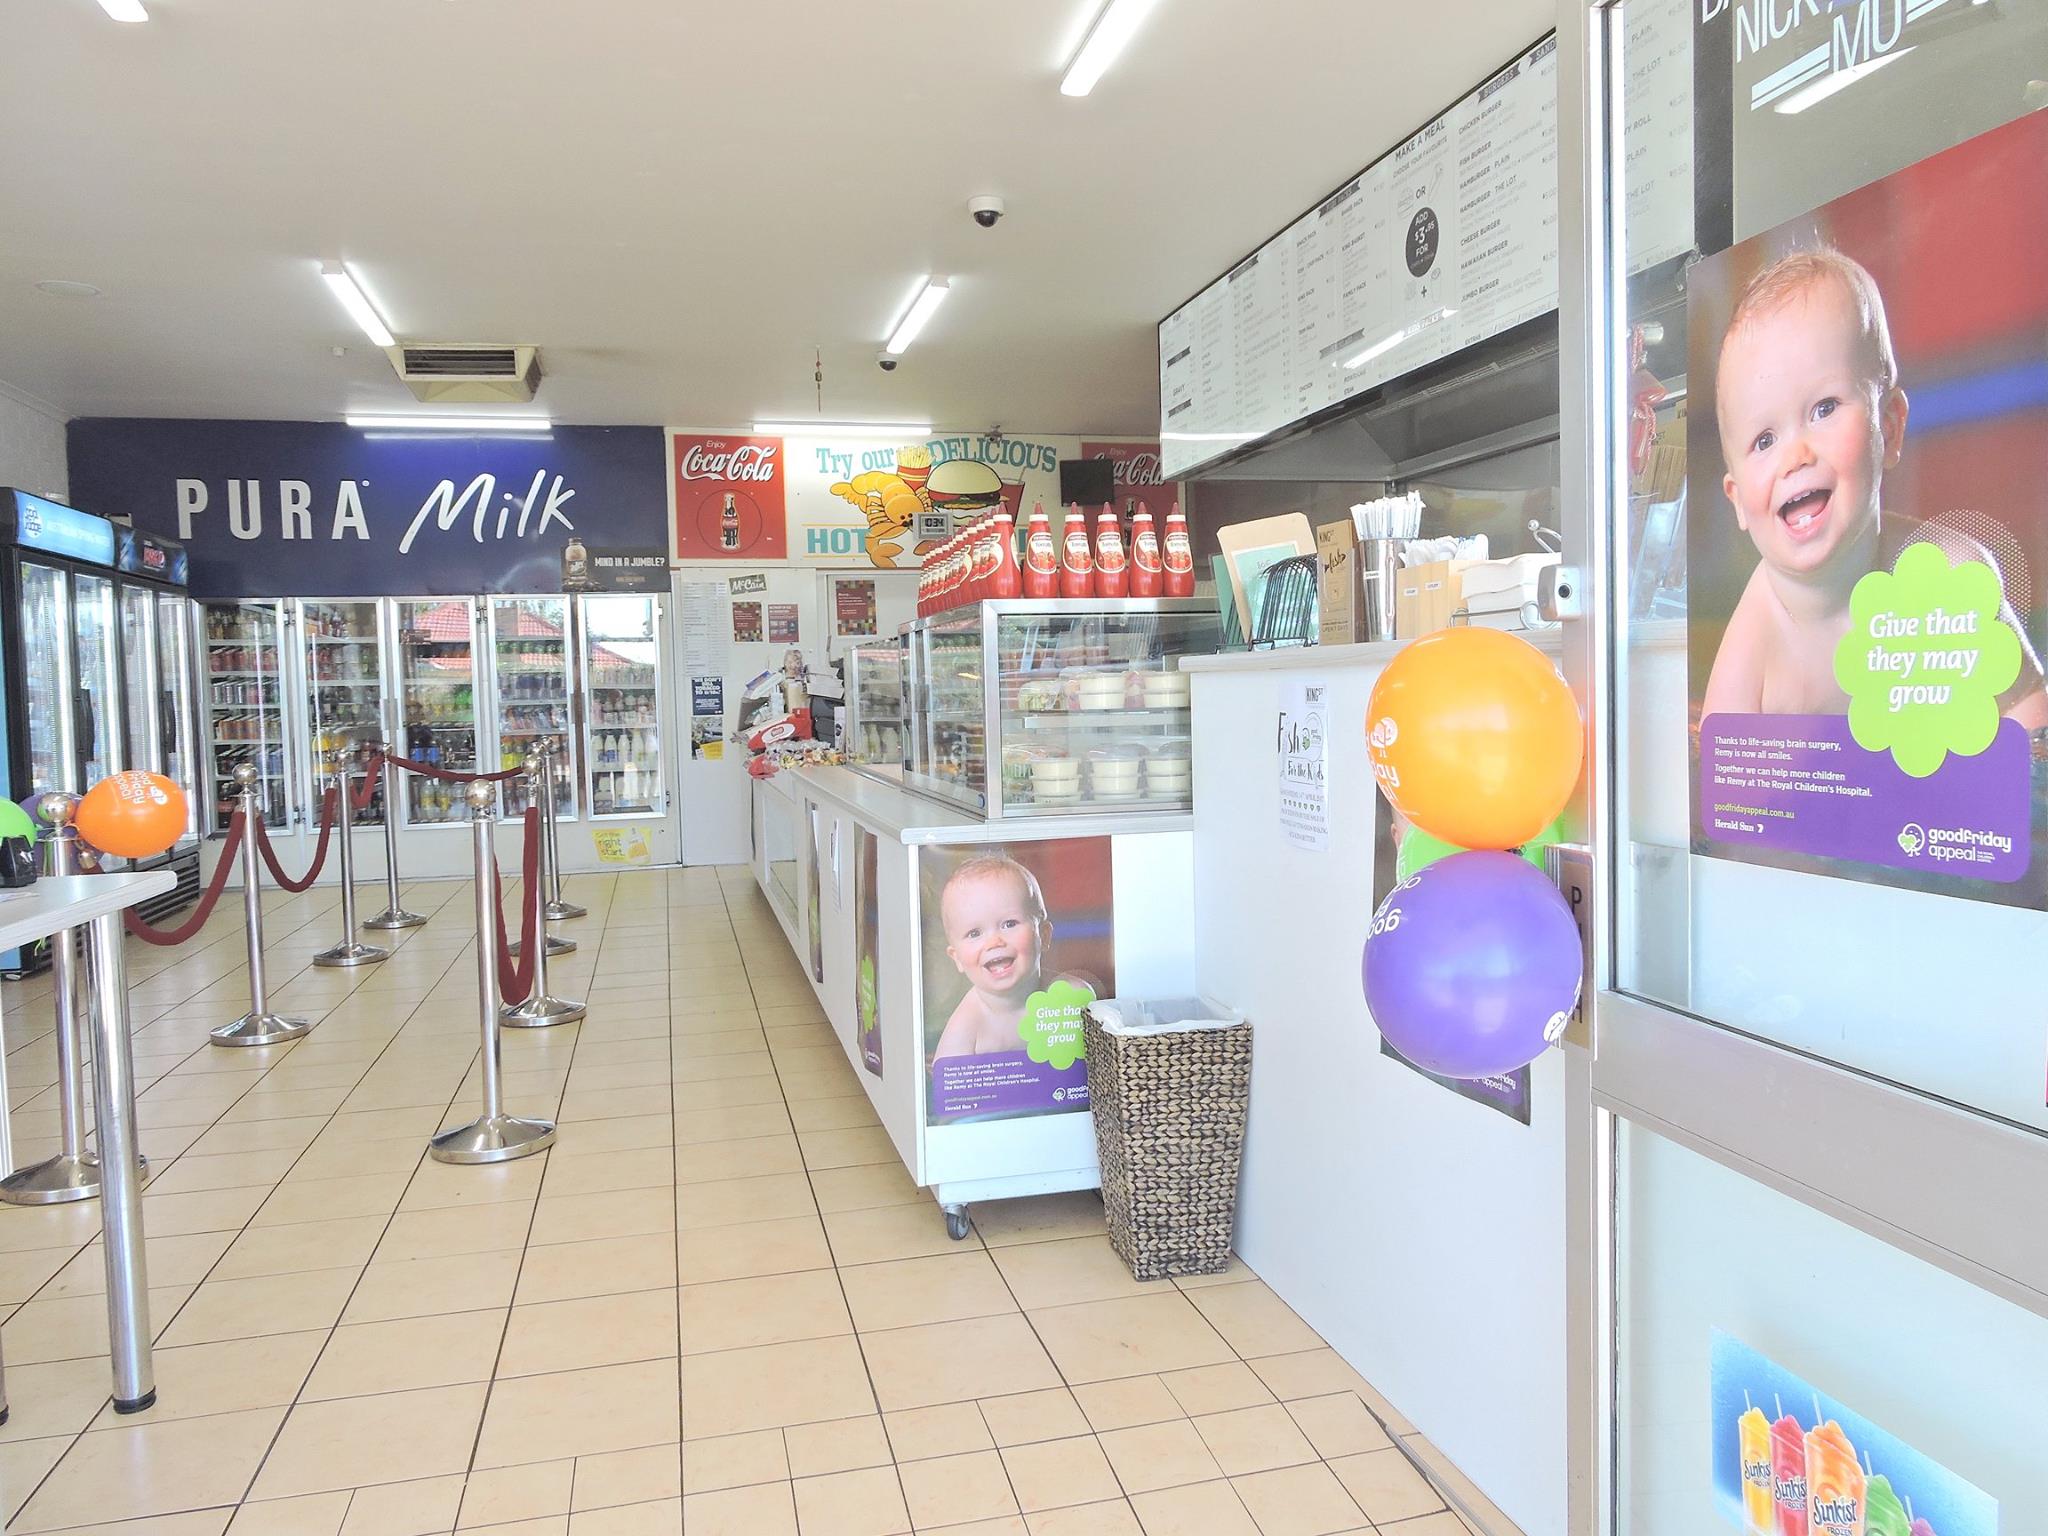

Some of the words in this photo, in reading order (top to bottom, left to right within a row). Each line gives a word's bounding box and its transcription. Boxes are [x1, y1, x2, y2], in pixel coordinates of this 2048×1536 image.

[1481, 99, 1502, 120] BURGER
[1395, 138, 1416, 162] MAKE
[1417, 134, 1423, 146] A
[1424, 118, 1446, 143] MEAL
[1471, 141, 1491, 160] BURGER
[1459, 166, 1491, 190] HAMBURGER
[1415, 185, 1426, 199] OR
[1459, 190, 1491, 214] HAMBURGER
[1414, 211, 1429, 226] ADD
[1460, 230, 1479, 247] CHEESE
[1480, 219, 1501, 236] BURGER
[1415, 243, 1429, 257] FOR
[1487, 240, 1508, 257] BURGER
[1479, 278, 1500, 295] BURGER
[706, 440, 727, 449] Enjoy
[681, 445, 777, 481] Coca-Cola
[816, 447, 854, 481] Try
[861, 447, 895, 471] our
[927, 437, 1057, 473] DELICIOUS
[175, 478, 371, 541] PURA
[397, 469, 577, 555] Milk
[807, 528, 872, 555] HOT
[630, 557, 665, 567] JUMBLE?
[731, 578, 766, 593] McCain
[1869, 611, 1919, 638] Give
[1925, 607, 1978, 636] that
[1867, 645, 1916, 679] they
[1922, 649, 1978, 678] may
[1888, 685, 1952, 713] grow
[1714, 736, 1739, 746] Thanks
[1748, 737, 1785, 750] life-saving
[1786, 739, 1807, 749] brain
[1808, 741, 1841, 752] surgery,
[1714, 748, 1733, 757] Remy
[1734, 749, 1741, 757] is
[1741, 751, 1756, 759] now
[1757, 751, 1766, 759] all
[1767, 751, 1793, 761] smiles.
[1714, 764, 1745, 775] Together
[1745, 767, 1756, 775] we
[1757, 768, 1771, 776] can
[1771, 767, 1789, 778] help
[1790, 770, 1811, 779] more
[1812, 770, 1845, 781] children
[1714, 775, 1726, 784] like
[1727, 776, 1747, 787] Remy
[1747, 779, 1756, 787] at
[1757, 778, 1771, 788] The
[1771, 779, 1793, 791] Royal
[1794, 781, 1834, 794] Children's
[1835, 785, 1873, 797] Hospital.
[1714, 802, 1795, 819] goodfridayappeal.com.au
[1714, 818, 1739, 829] Herald
[1739, 822, 1754, 832] Sun
[1928, 828, 2012, 853] goodfriday
[1928, 844, 1976, 862] appeal
[1036, 1007, 1061, 1018] Give
[1063, 1004, 1081, 1016] tha
[1036, 1020, 1060, 1033] they
[1047, 1033, 1076, 1047] grow
[1744, 1459, 1771, 1480] Sunkis
[1813, 1496, 1857, 1525] Sunkist
